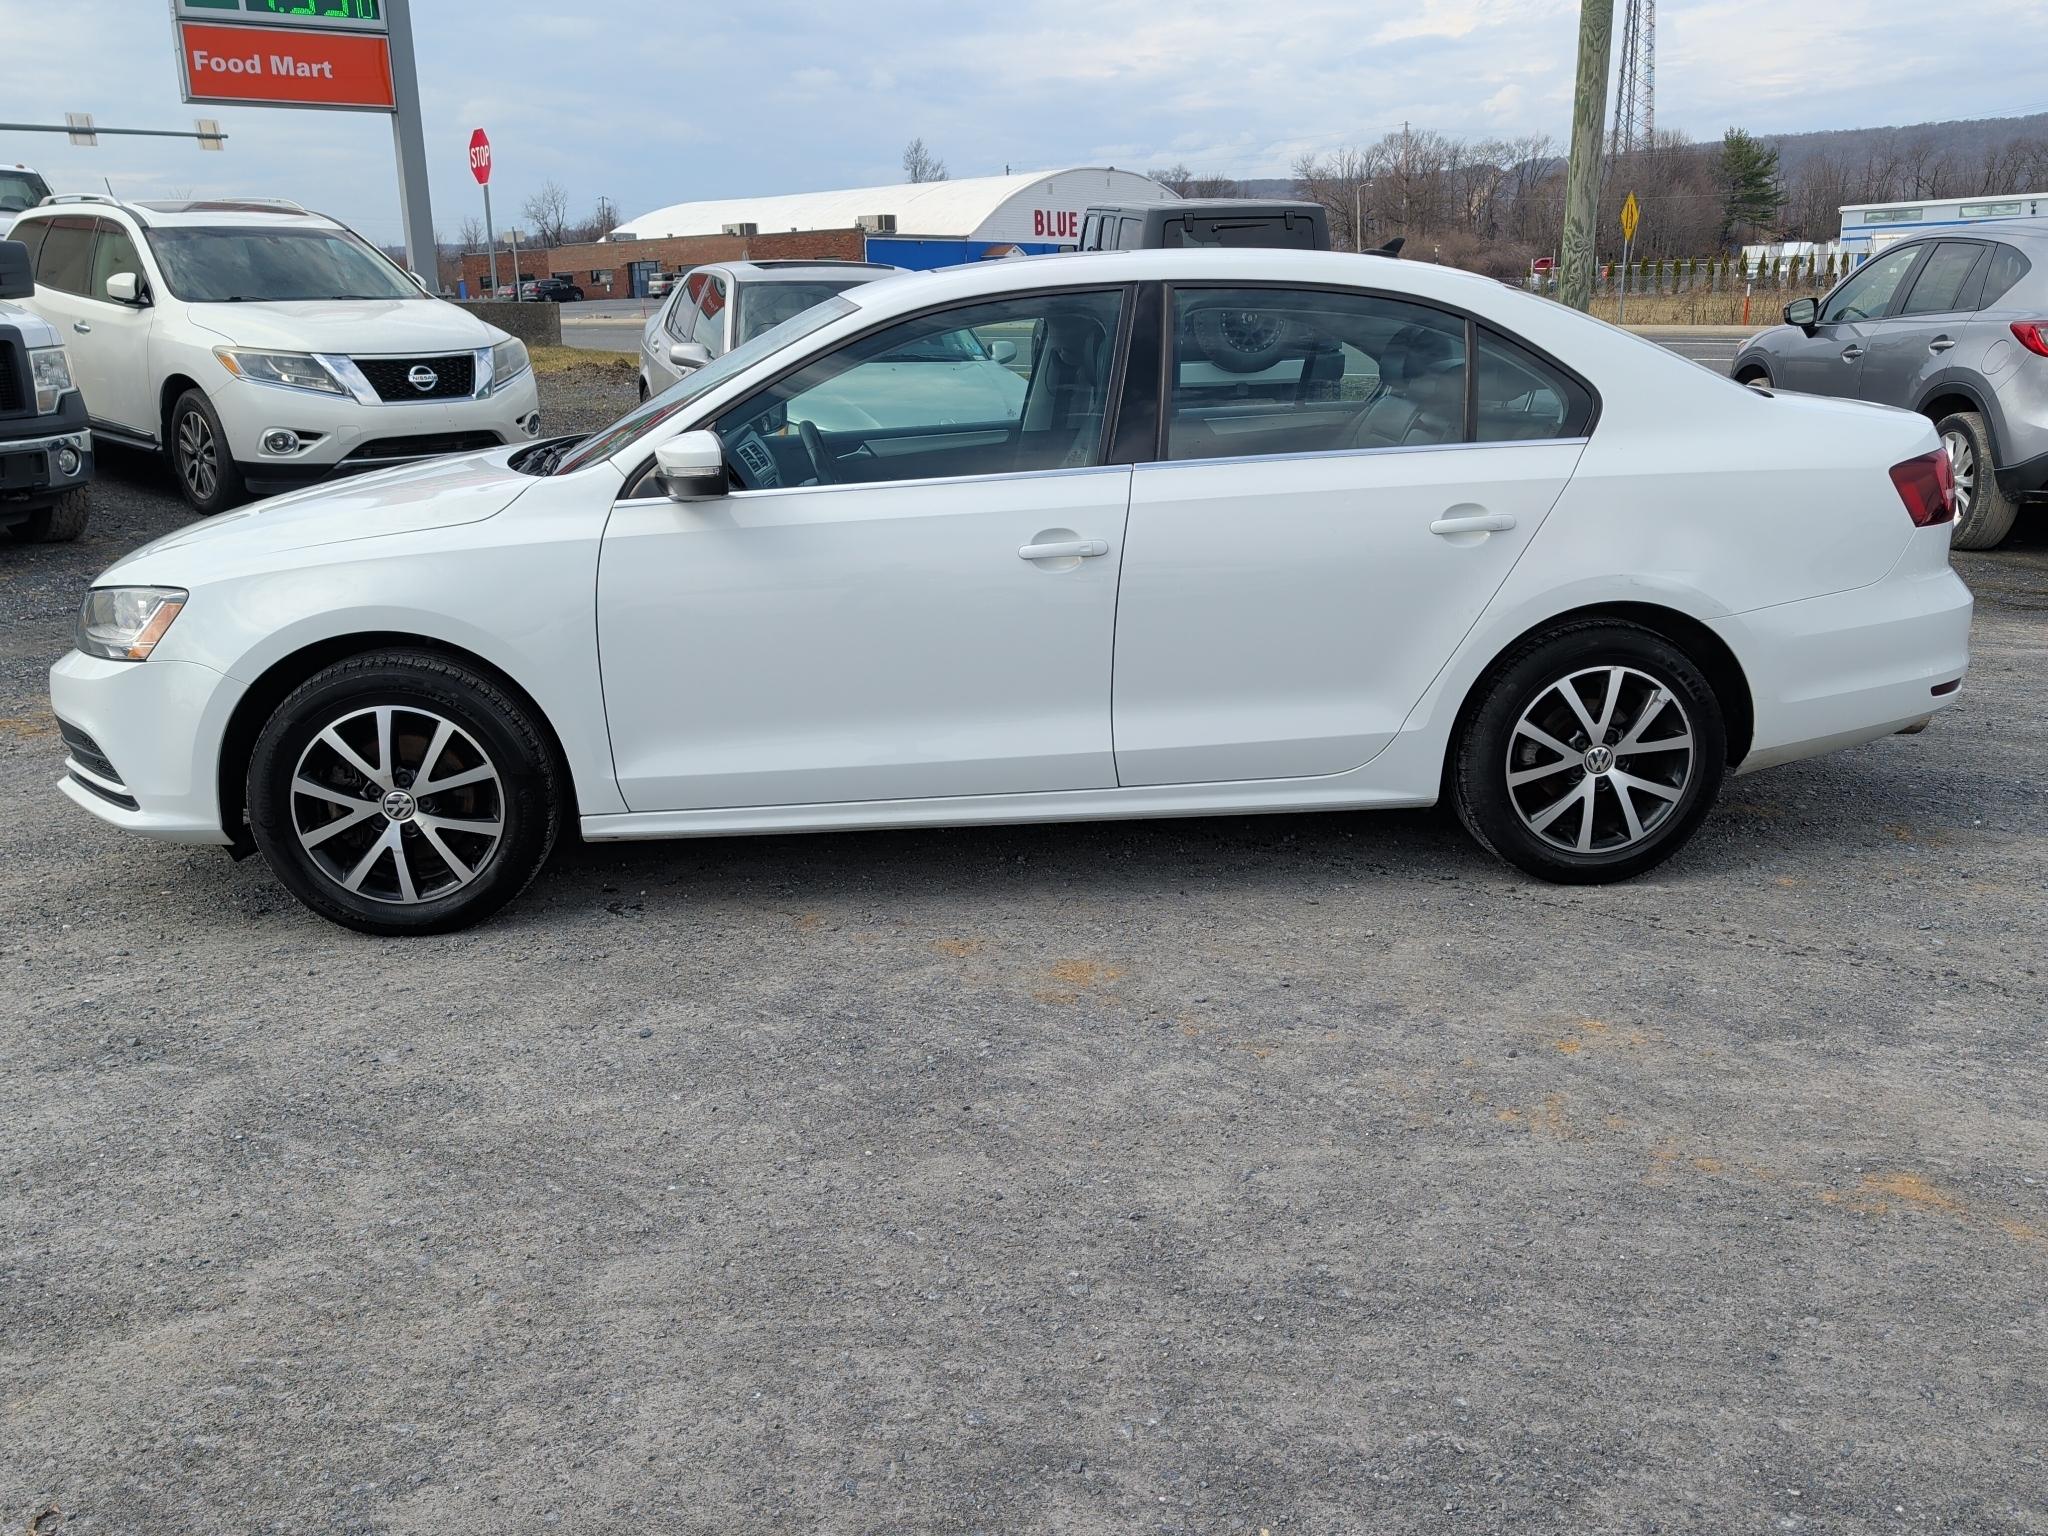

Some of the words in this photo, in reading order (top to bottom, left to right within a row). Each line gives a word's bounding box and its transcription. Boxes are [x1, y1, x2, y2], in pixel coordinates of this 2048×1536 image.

[192, 50, 262, 75] Food
[269, 54, 334, 79] Mart
[471, 145, 490, 168] STOP
[1034, 209, 1078, 237] BLUE
